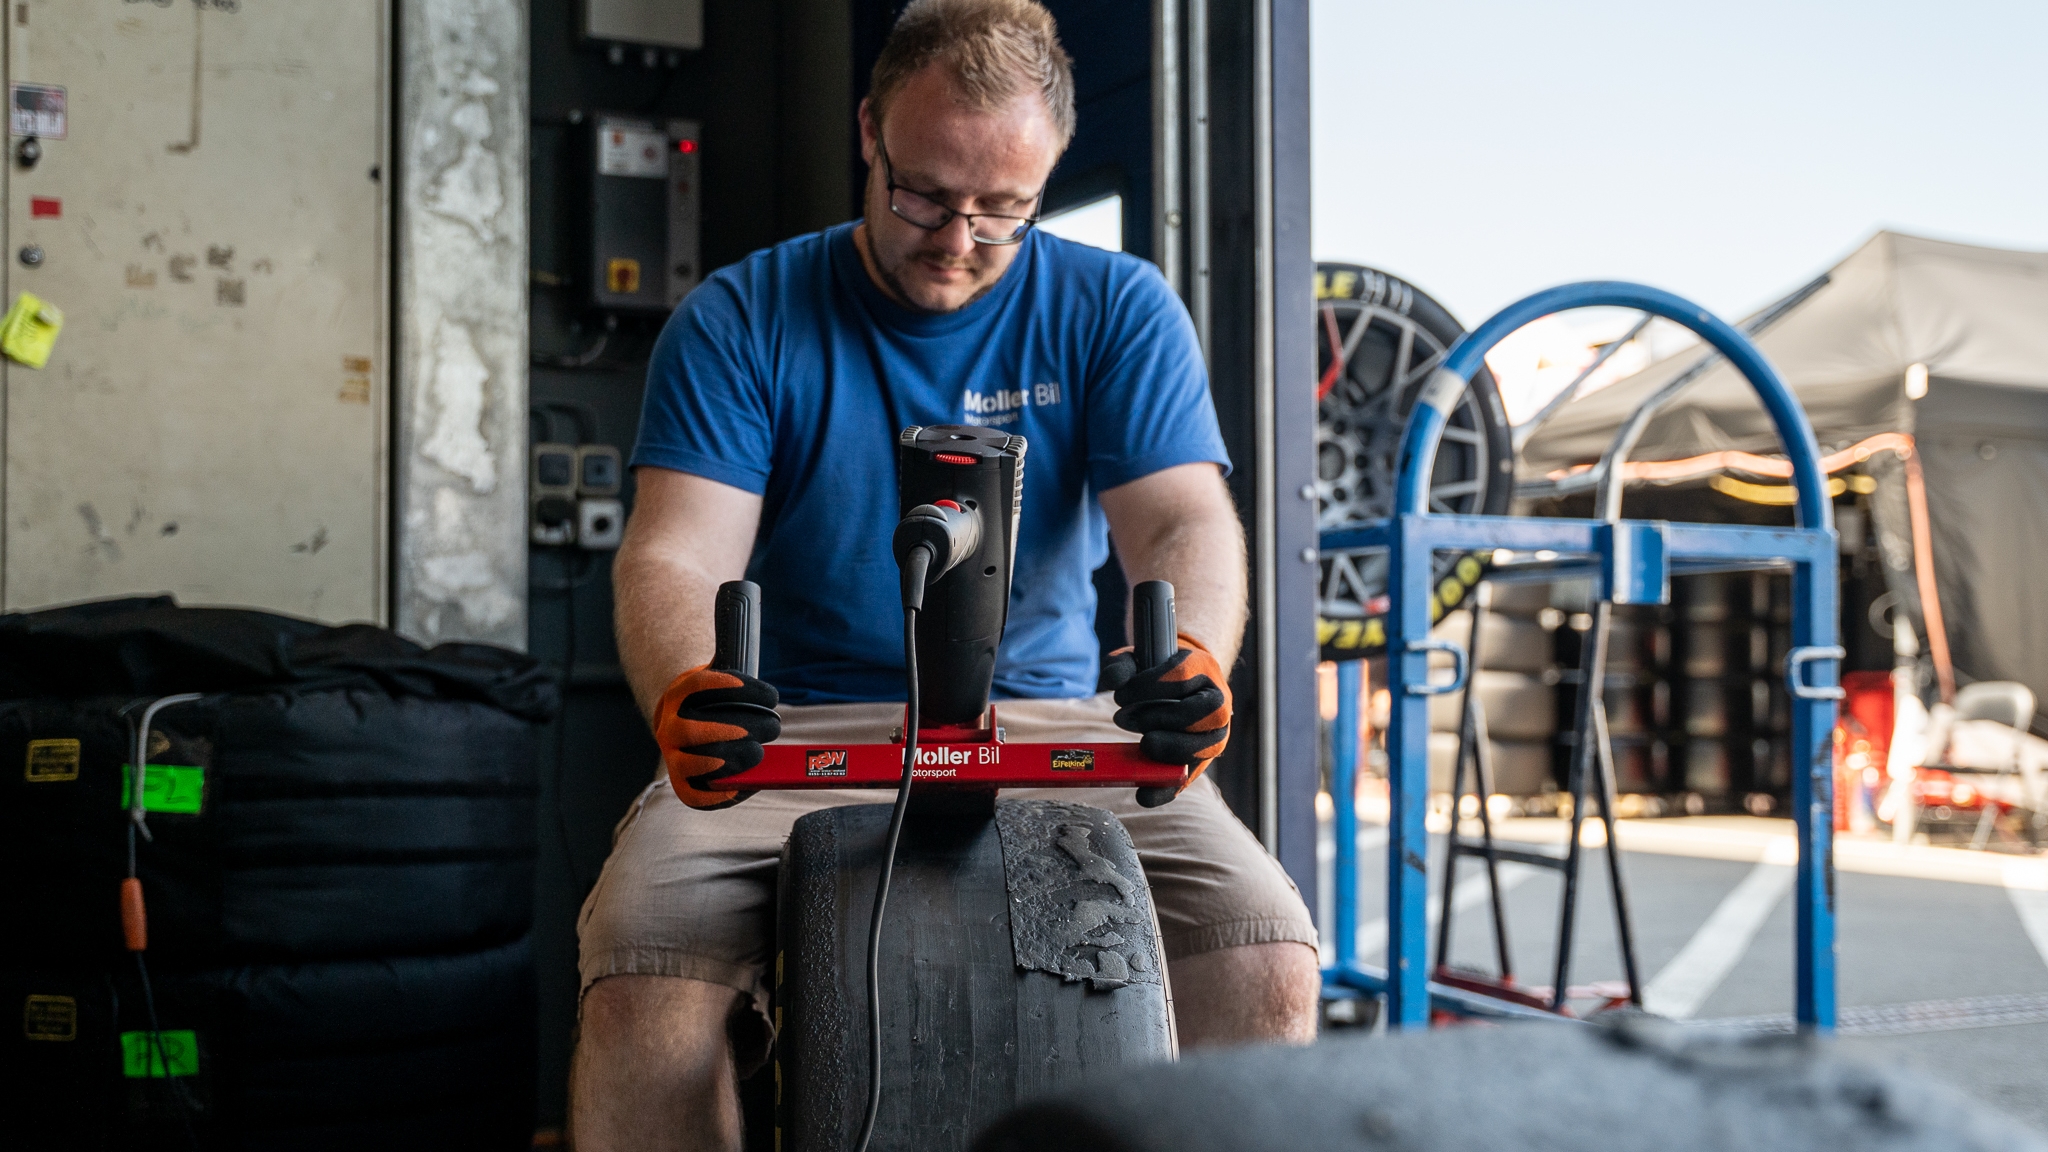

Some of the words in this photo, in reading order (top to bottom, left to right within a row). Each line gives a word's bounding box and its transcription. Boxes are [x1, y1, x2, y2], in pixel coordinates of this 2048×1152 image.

[1034, 382, 1061, 406] Bil
[808, 751, 846, 770] RSW
[978, 746, 1000, 764] Bil
[901, 768, 957, 779] otorsport
